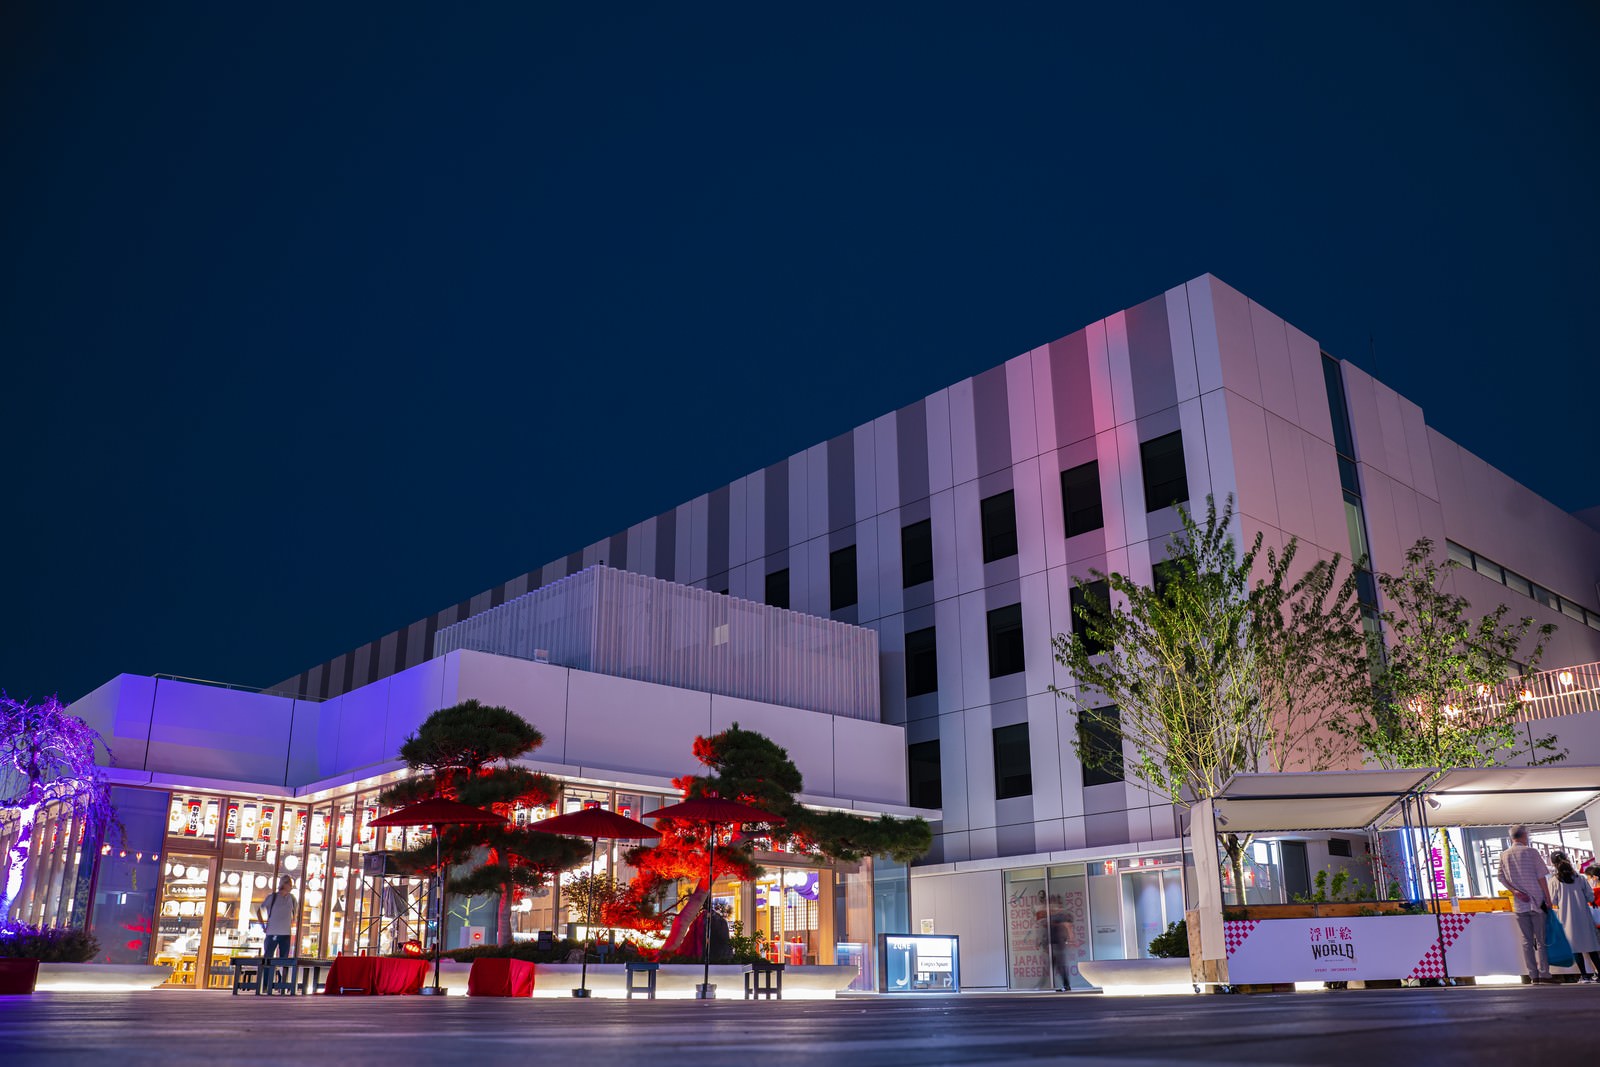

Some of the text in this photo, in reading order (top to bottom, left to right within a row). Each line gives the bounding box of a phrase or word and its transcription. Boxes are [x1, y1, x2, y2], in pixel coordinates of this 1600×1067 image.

[1309, 926, 1352, 942] 浮世絵
[1311, 943, 1354, 960] WORLD
